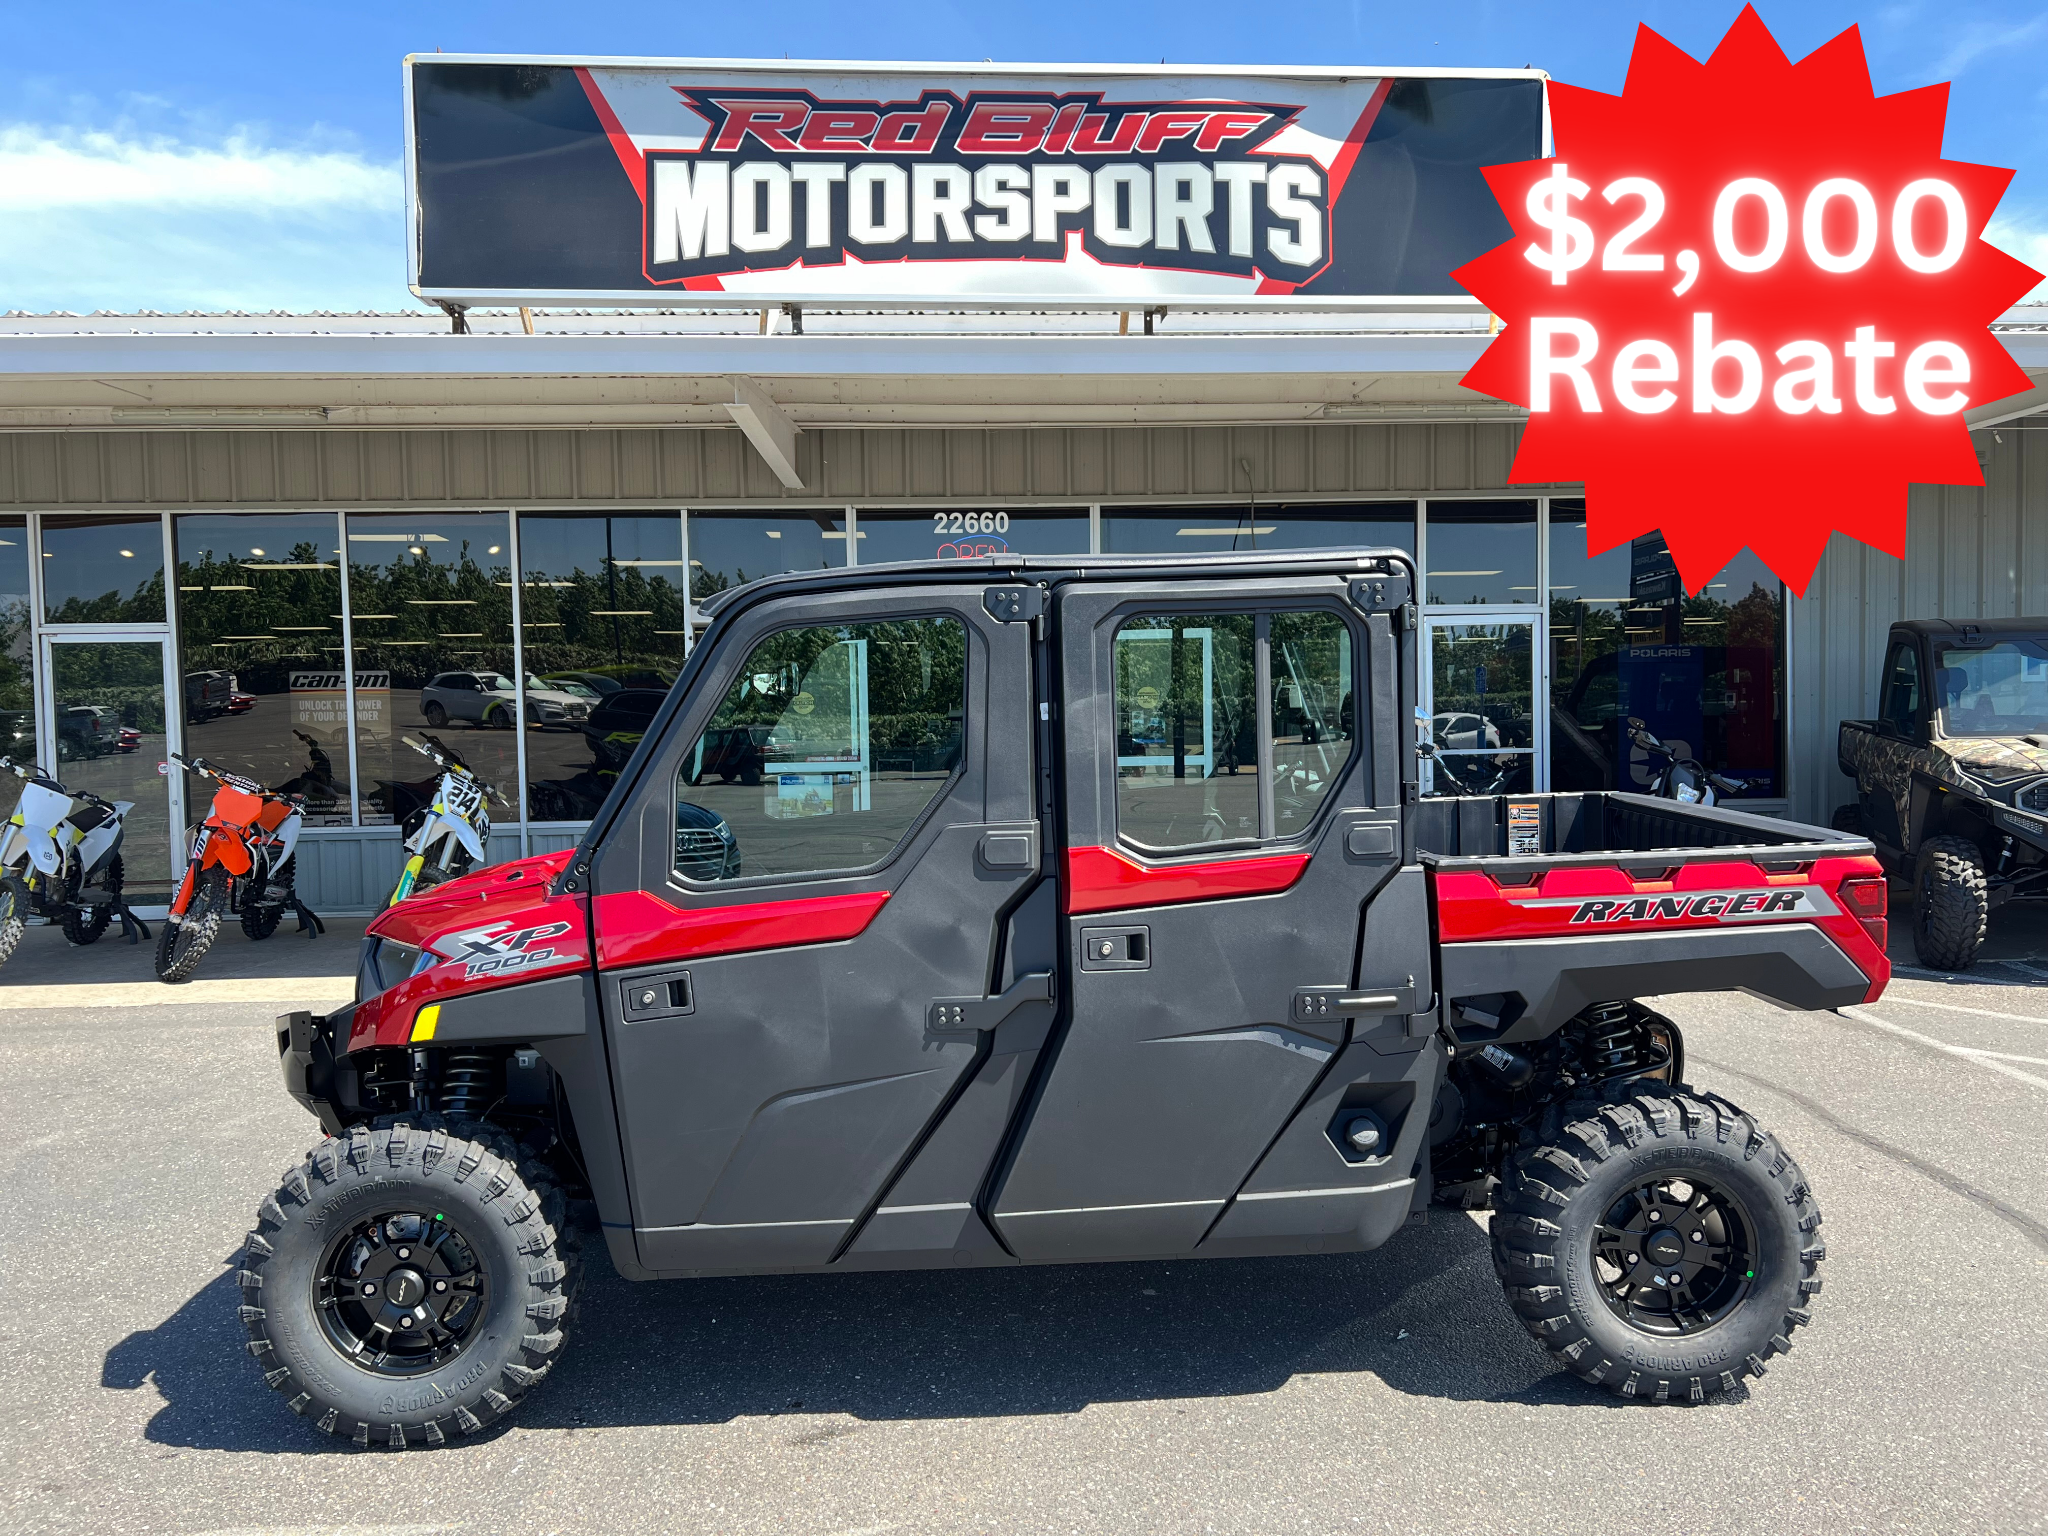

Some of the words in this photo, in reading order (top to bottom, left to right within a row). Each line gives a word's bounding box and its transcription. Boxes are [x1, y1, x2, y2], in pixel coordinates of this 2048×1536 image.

[710, 99, 951, 153] Red
[953, 101, 1275, 155] Bluff
[653, 161, 1323, 267] MOTORSPORTS
[933, 511, 1010, 534] 22660
[1630, 648, 1691, 658] POLARIS
[299, 700, 332, 711] UNLOCK
[334, 700, 347, 710] TH
[300, 711, 310, 721] OF
[313, 711, 335, 721] YOUR
[337, 710, 379, 721] DENDER
[446, 784, 478, 813] 214
[1569, 889, 1805, 923] RANGER
[441, 921, 573, 968] XP
[464, 948, 554, 977] 1000
[301, 1178, 411, 1231] X-TERRAIN
[1634, 1351, 1695, 1371] ARMOR
[1697, 1346, 1730, 1367] PRO
